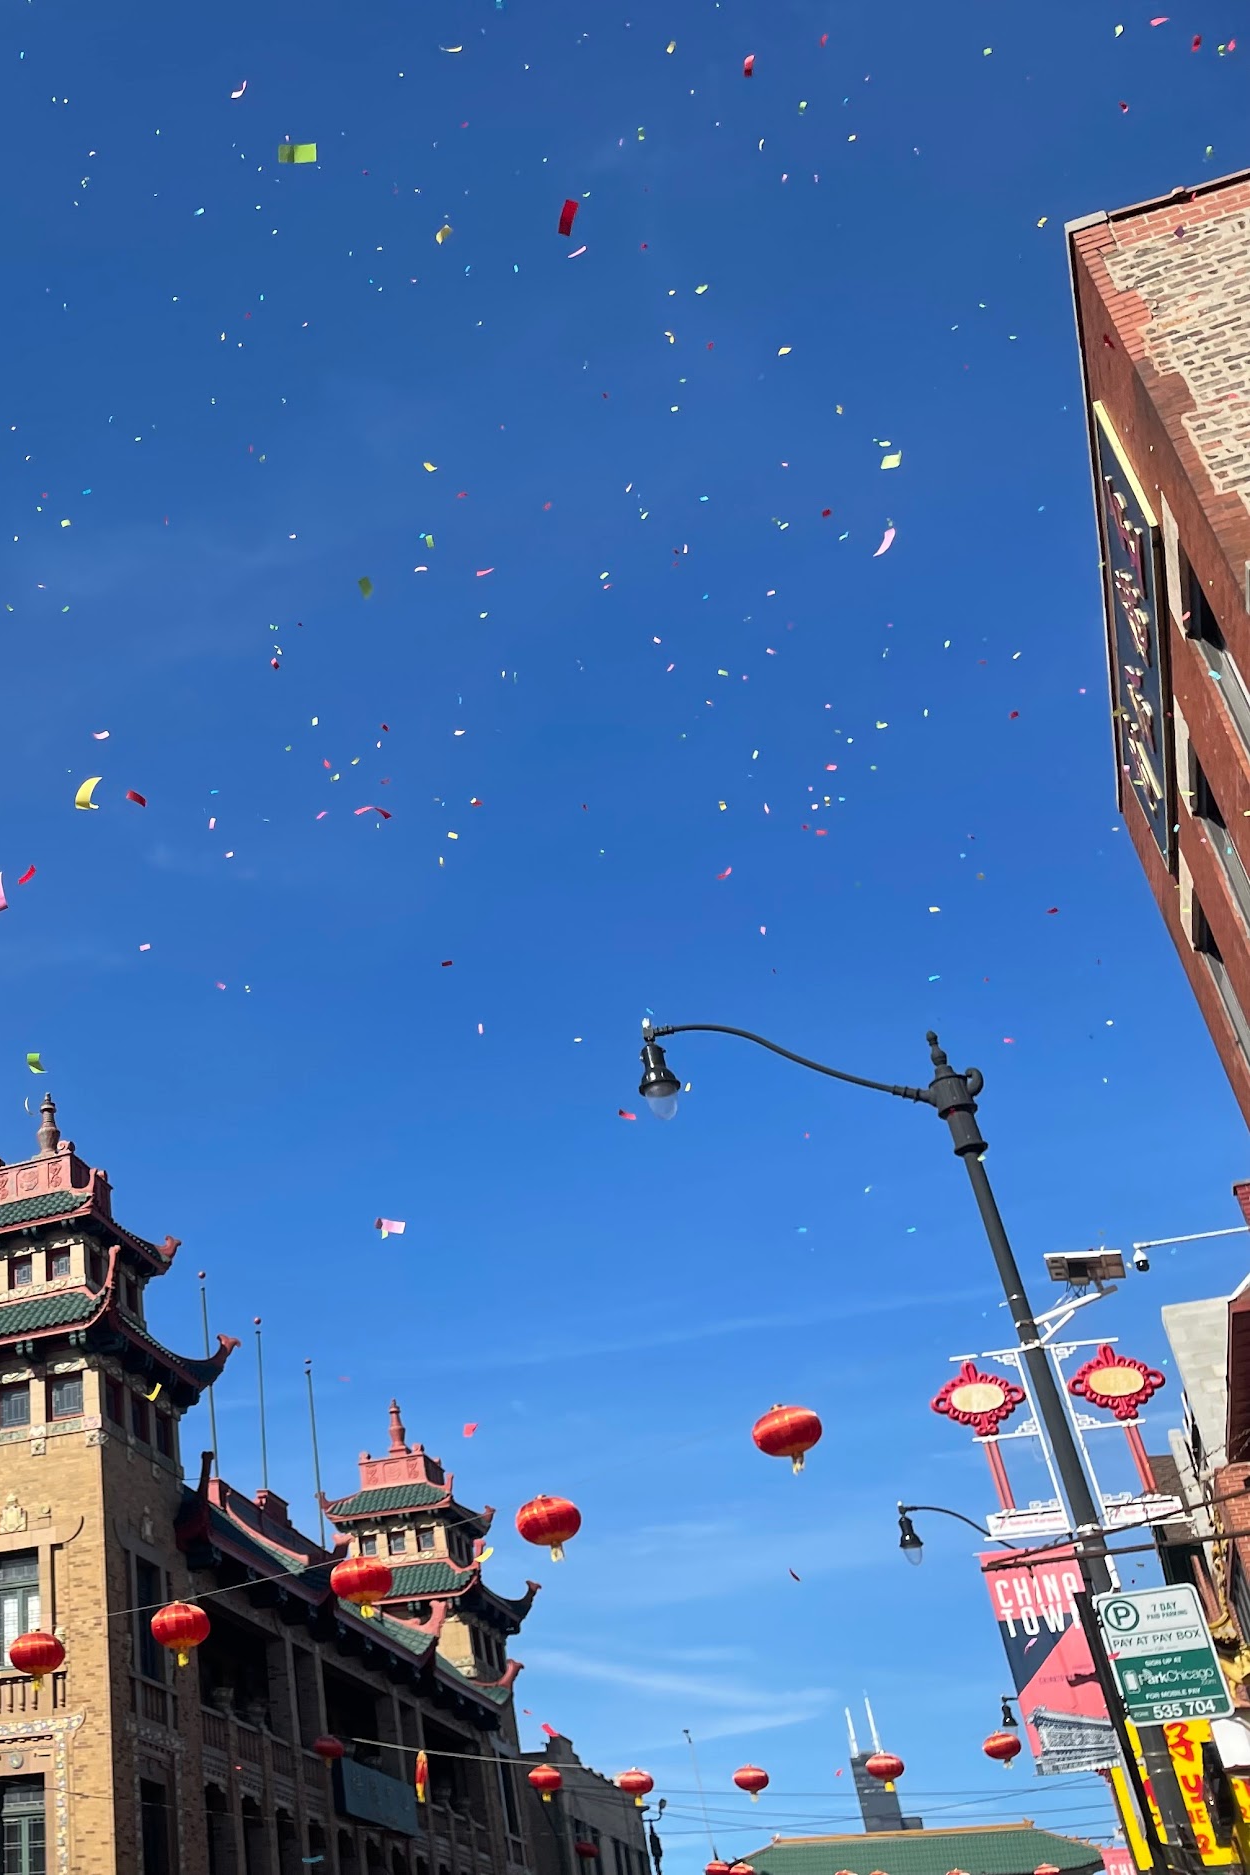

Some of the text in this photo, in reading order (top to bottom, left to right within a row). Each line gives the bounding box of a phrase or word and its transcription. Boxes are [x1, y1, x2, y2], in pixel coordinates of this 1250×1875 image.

[995, 1572, 1079, 1608] CHINA
[1160, 1601, 1177, 1611] DAY
[1112, 1606, 1131, 1626] P
[1112, 1628, 1201, 1649] PAY AT PAY BOX
[1144, 1655, 1182, 1668] SIGN UP AT
[1137, 1667, 1214, 1686] ParkChicago
[1145, 1687, 1201, 1700] FOR MOBILE PAY
[1152, 1703, 1183, 1720] 535
[1185, 1698, 1217, 1715] 704
